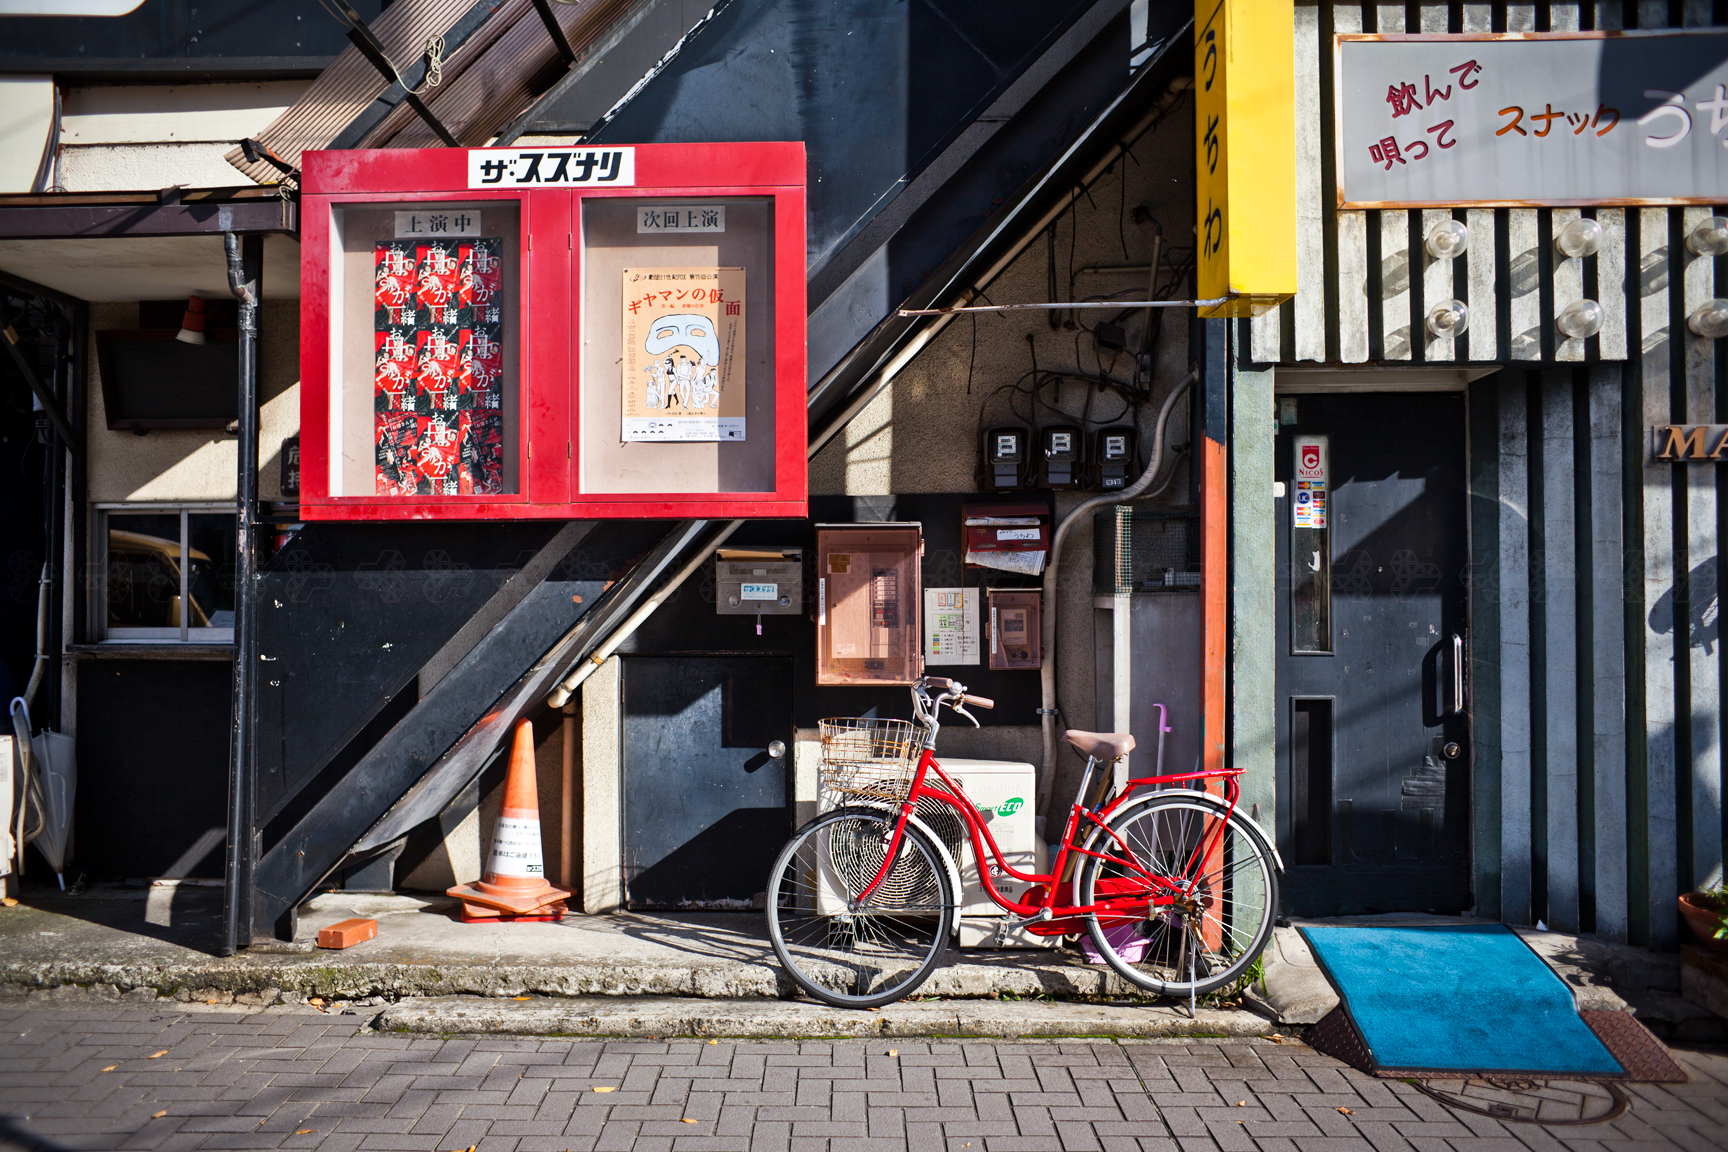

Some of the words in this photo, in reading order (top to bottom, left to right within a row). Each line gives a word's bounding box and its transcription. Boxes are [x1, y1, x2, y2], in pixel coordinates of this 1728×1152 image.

[1385, 59, 1483, 119] 飲んで
[1494, 103, 1621, 138] スナック
[1203, 28, 1222, 261] うちわ
[1368, 119, 1457, 171] 唄って
[405, 213, 471, 234] 上演中
[643, 209, 719, 229] 次回上演
[628, 288, 741, 317] ギヤマンの仮面
[973, 784, 1024, 794] TOSHIBA
[999, 802, 1022, 812] ECO
